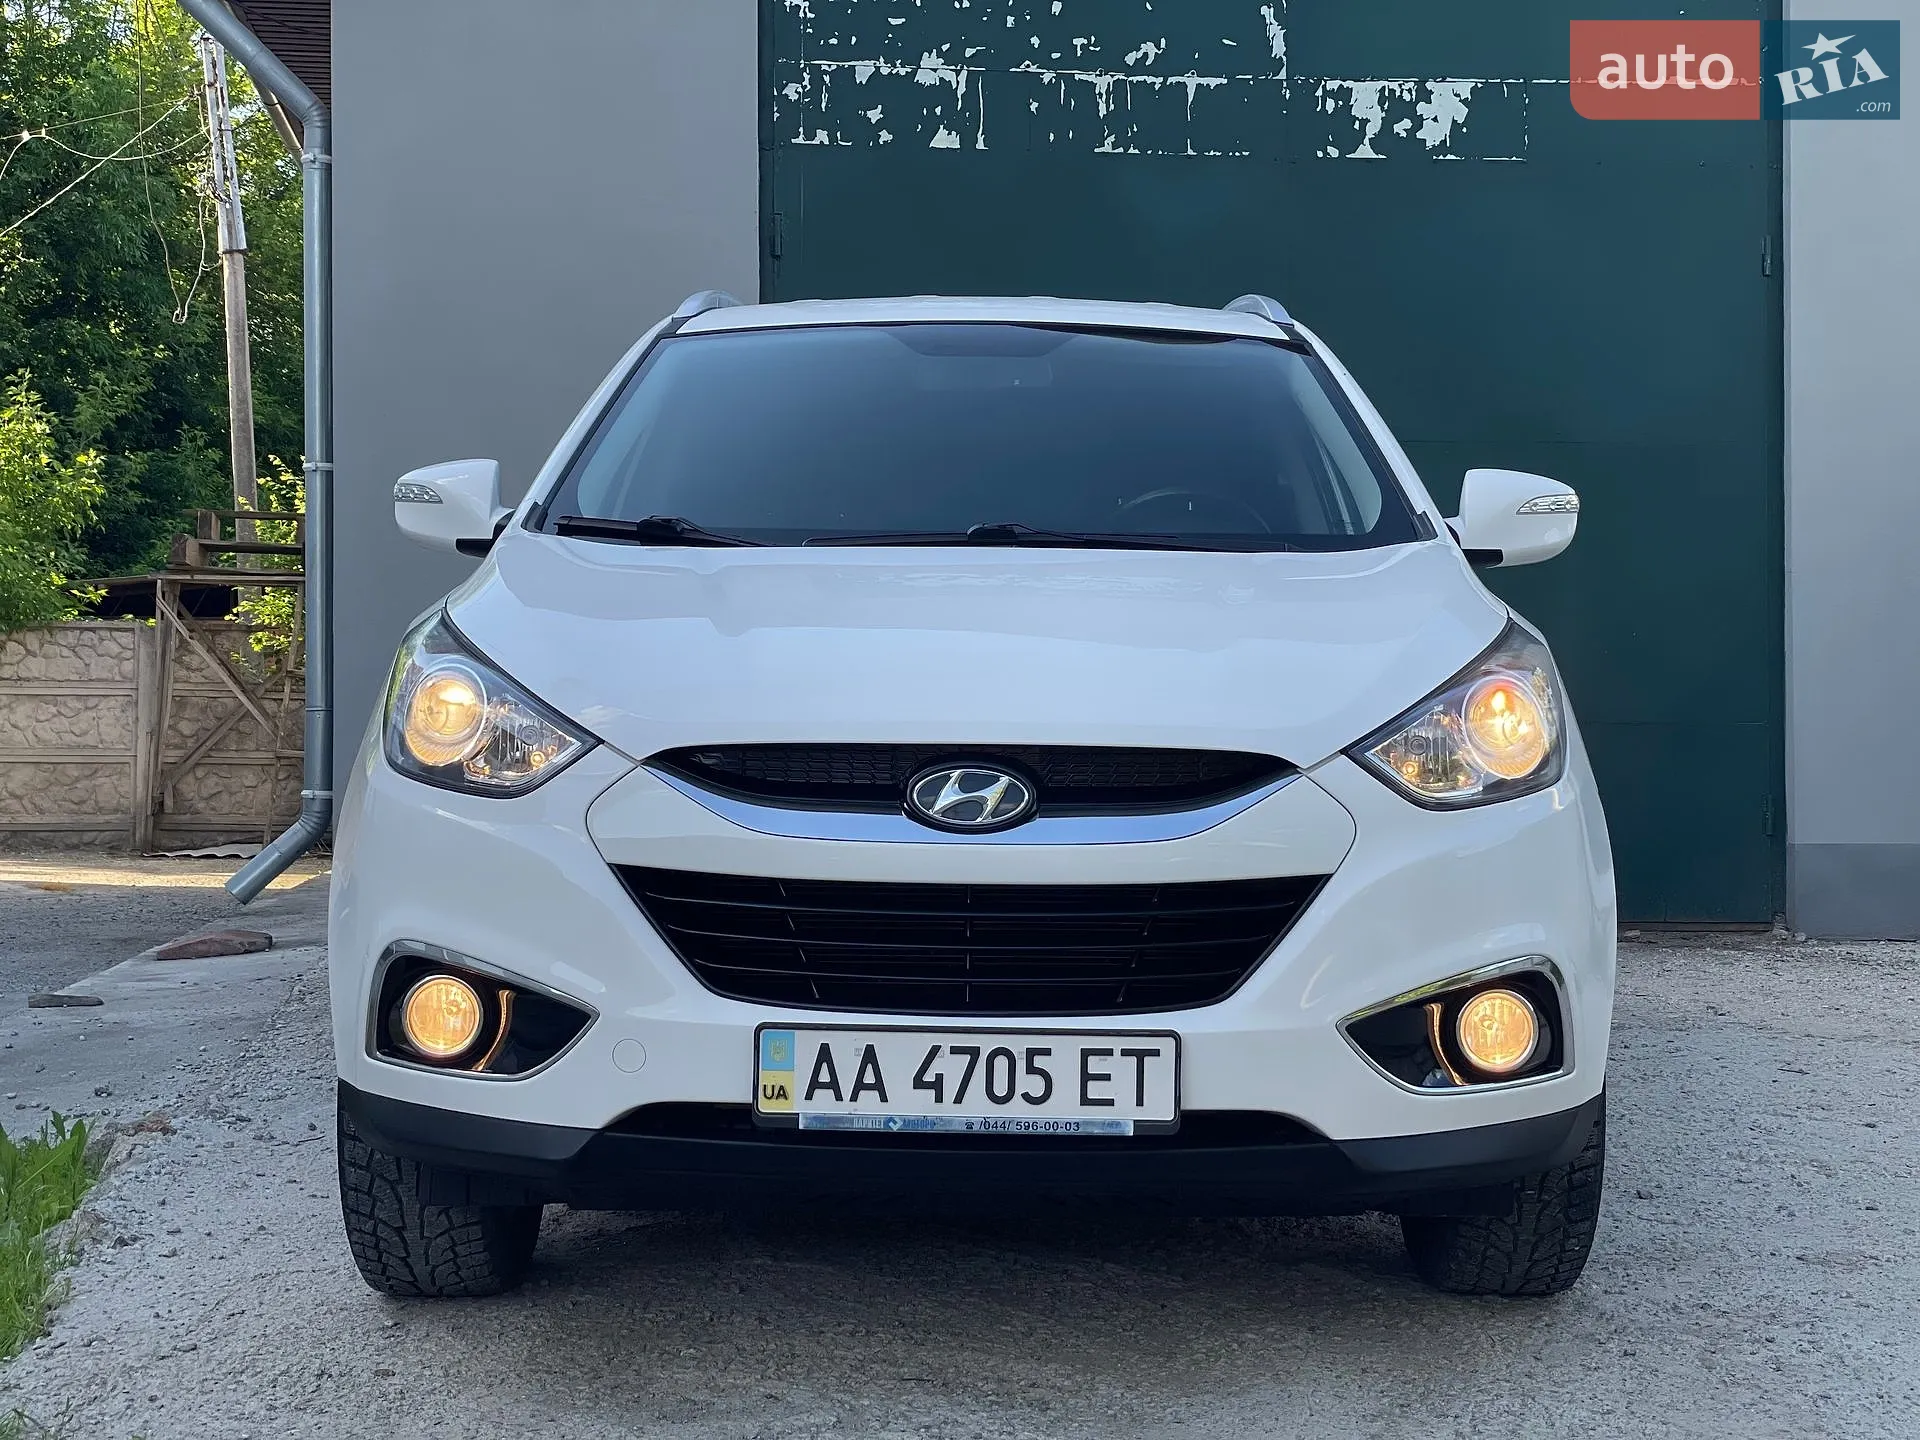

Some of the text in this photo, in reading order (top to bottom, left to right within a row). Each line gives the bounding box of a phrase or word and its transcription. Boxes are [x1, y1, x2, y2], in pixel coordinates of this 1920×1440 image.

[804, 1042, 1161, 1107] AA 4705 ET
[763, 1084, 788, 1101] UA
[1015, 1120, 1081, 1132] 596-00-03
